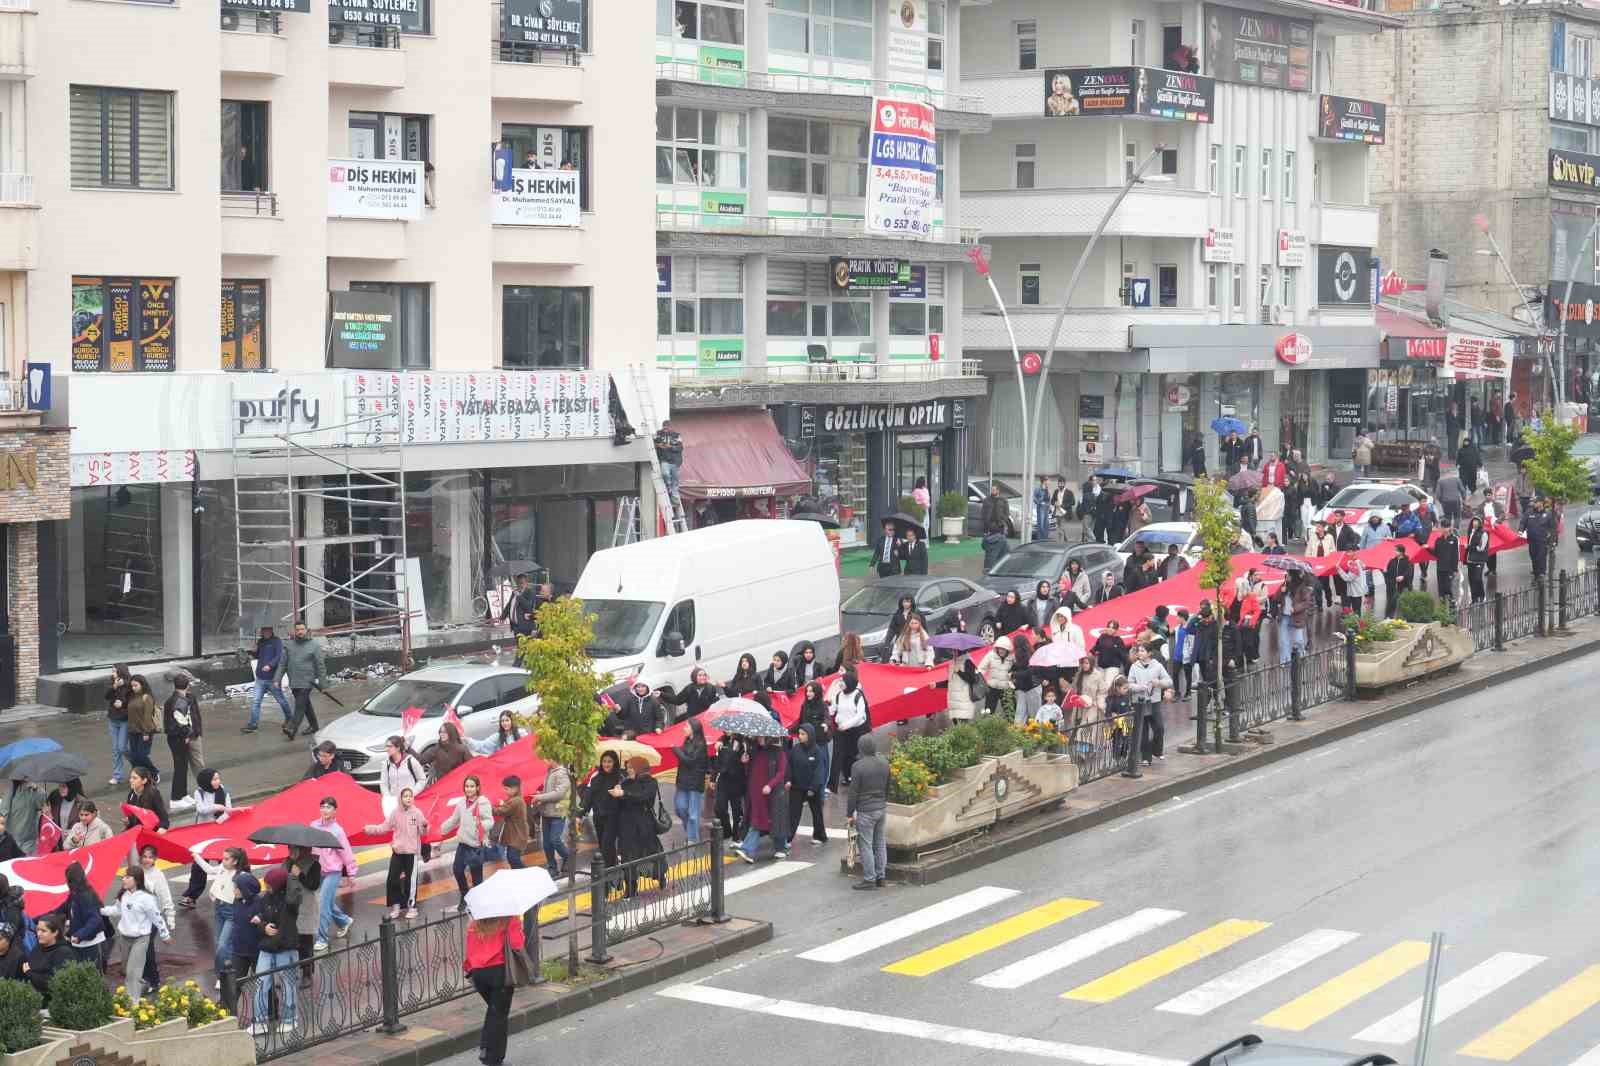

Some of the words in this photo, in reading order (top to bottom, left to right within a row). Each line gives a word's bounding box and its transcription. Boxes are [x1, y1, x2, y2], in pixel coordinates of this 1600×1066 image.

[511, 14, 522, 26] DR.
[523, 15, 543, 30] CİVAN
[546, 17, 581, 34] SÖYLEMEZ
[1084, 75, 1127, 85] ZENOVA
[876, 138, 895, 159] LGS
[347, 166, 368, 185] DİŞ
[372, 168, 416, 185] HEKİMİ
[512, 176, 524, 195] İŞ
[528, 177, 576, 195] HEKİMİ
[239, 388, 320, 434] puffy
[423, 384, 431, 418] AKPA
[460, 400, 498, 415] YATAK
[507, 400, 541, 415] BAZA
[408, 409, 416, 443] AKPA
[825, 403, 905, 431] GÖZLÜKÇÜM
[909, 401, 946, 425] OPTİK
